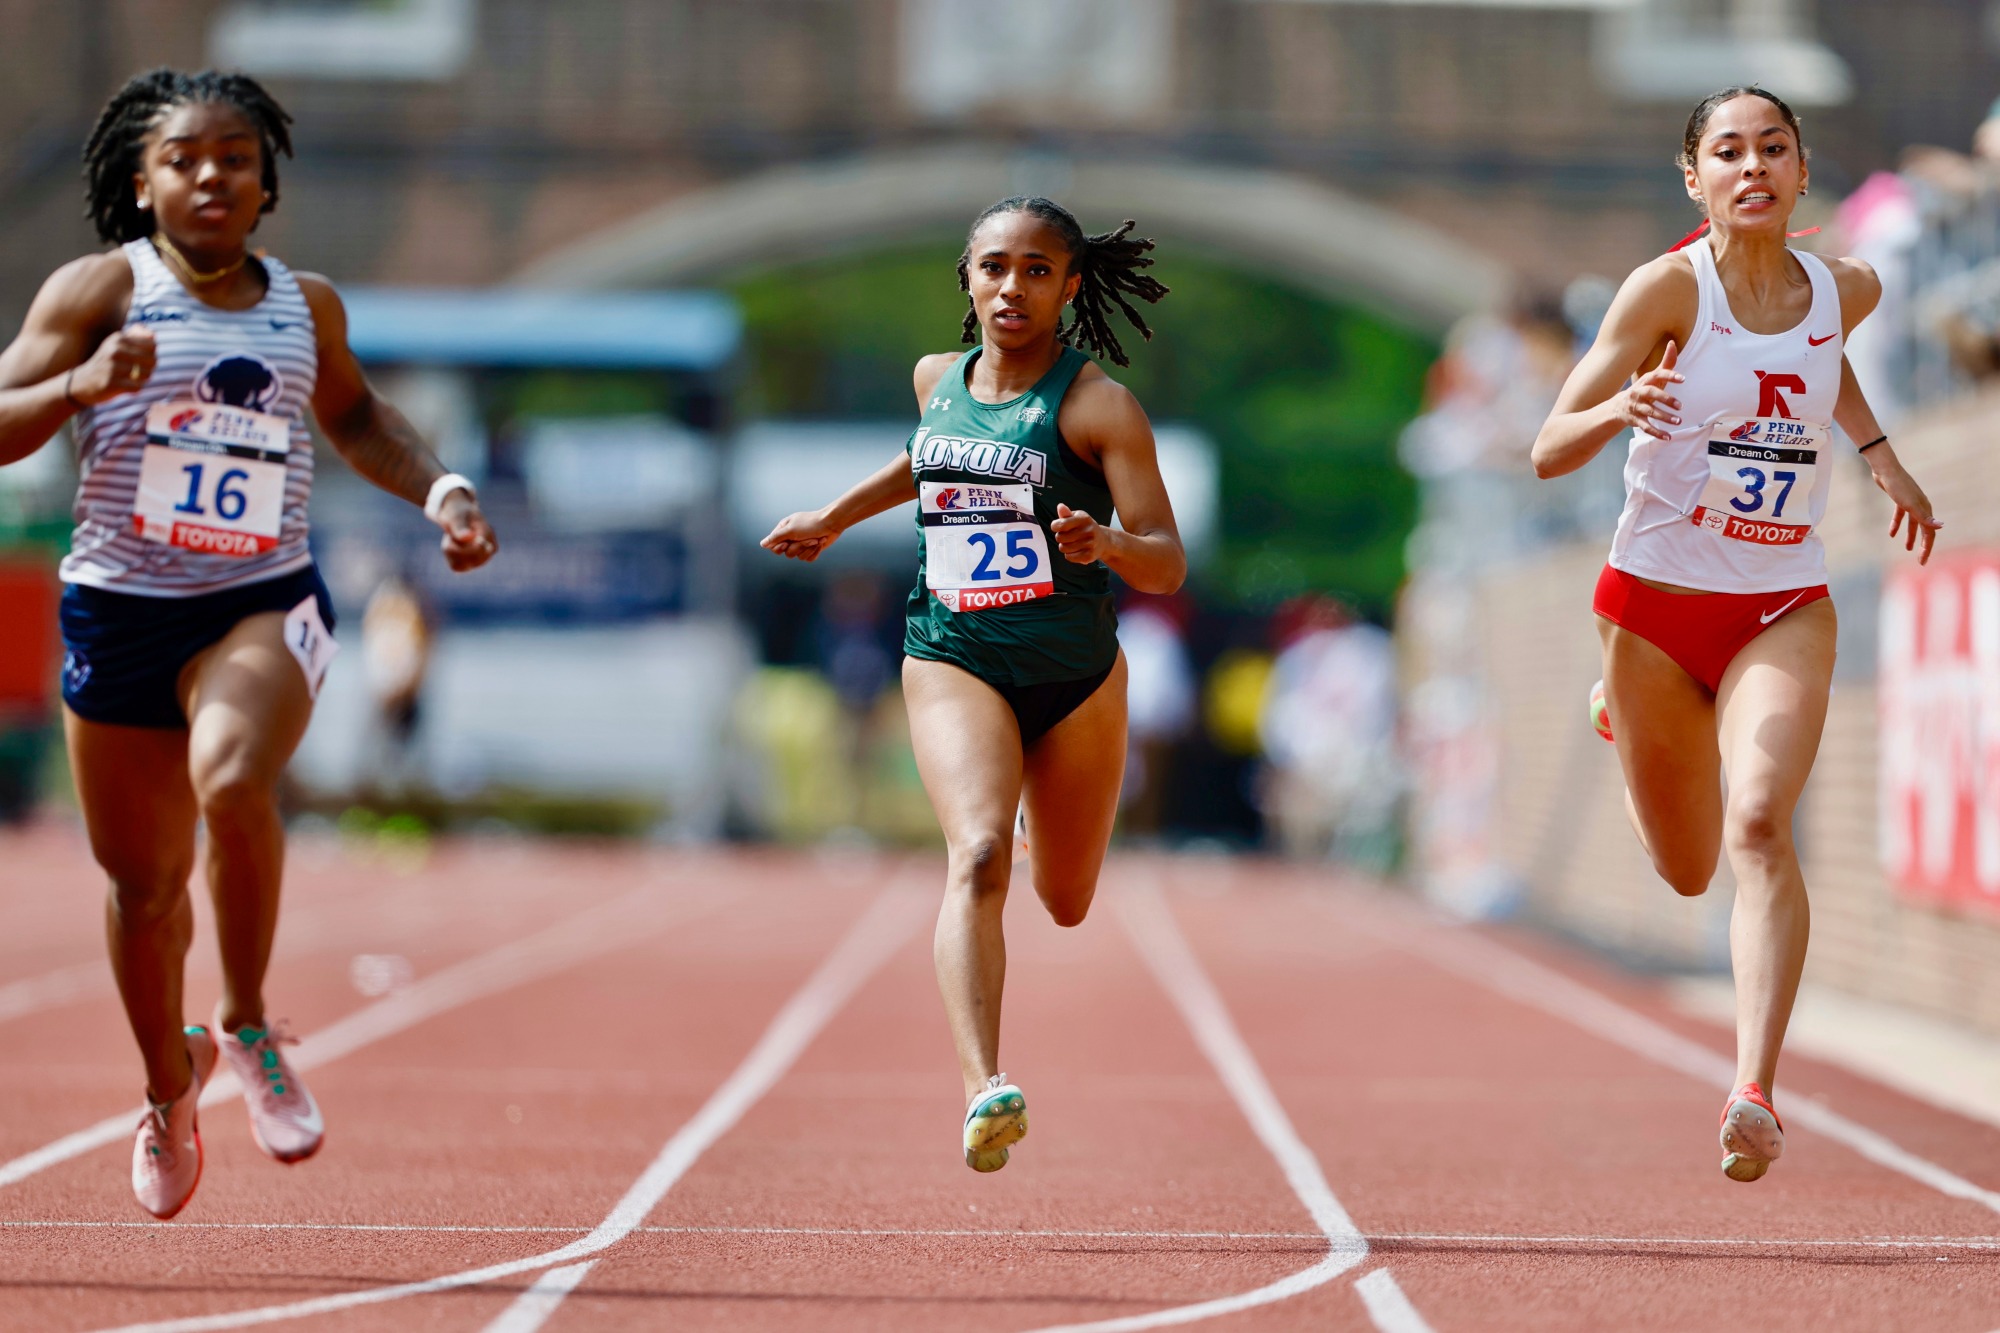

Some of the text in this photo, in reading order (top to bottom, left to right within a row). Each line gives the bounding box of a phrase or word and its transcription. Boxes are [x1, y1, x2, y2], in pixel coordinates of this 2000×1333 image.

[1767, 421, 1806, 436] PENN
[1763, 433, 1814, 446] RELAYS
[912, 427, 1047, 488] LOYOLA
[1728, 445, 1780, 461] Dream On.
[174, 463, 249, 521] 16
[967, 487, 1003, 499] PENN
[1729, 466, 1797, 518] 37
[968, 497, 1018, 509] RELAYS
[942, 513, 988, 524] Dream On.
[175, 524, 259, 554] TOYOTA
[1731, 520, 1796, 542] TOYOTA
[966, 529, 1039, 581] 25
[963, 588, 1037, 607] TOYOTA
